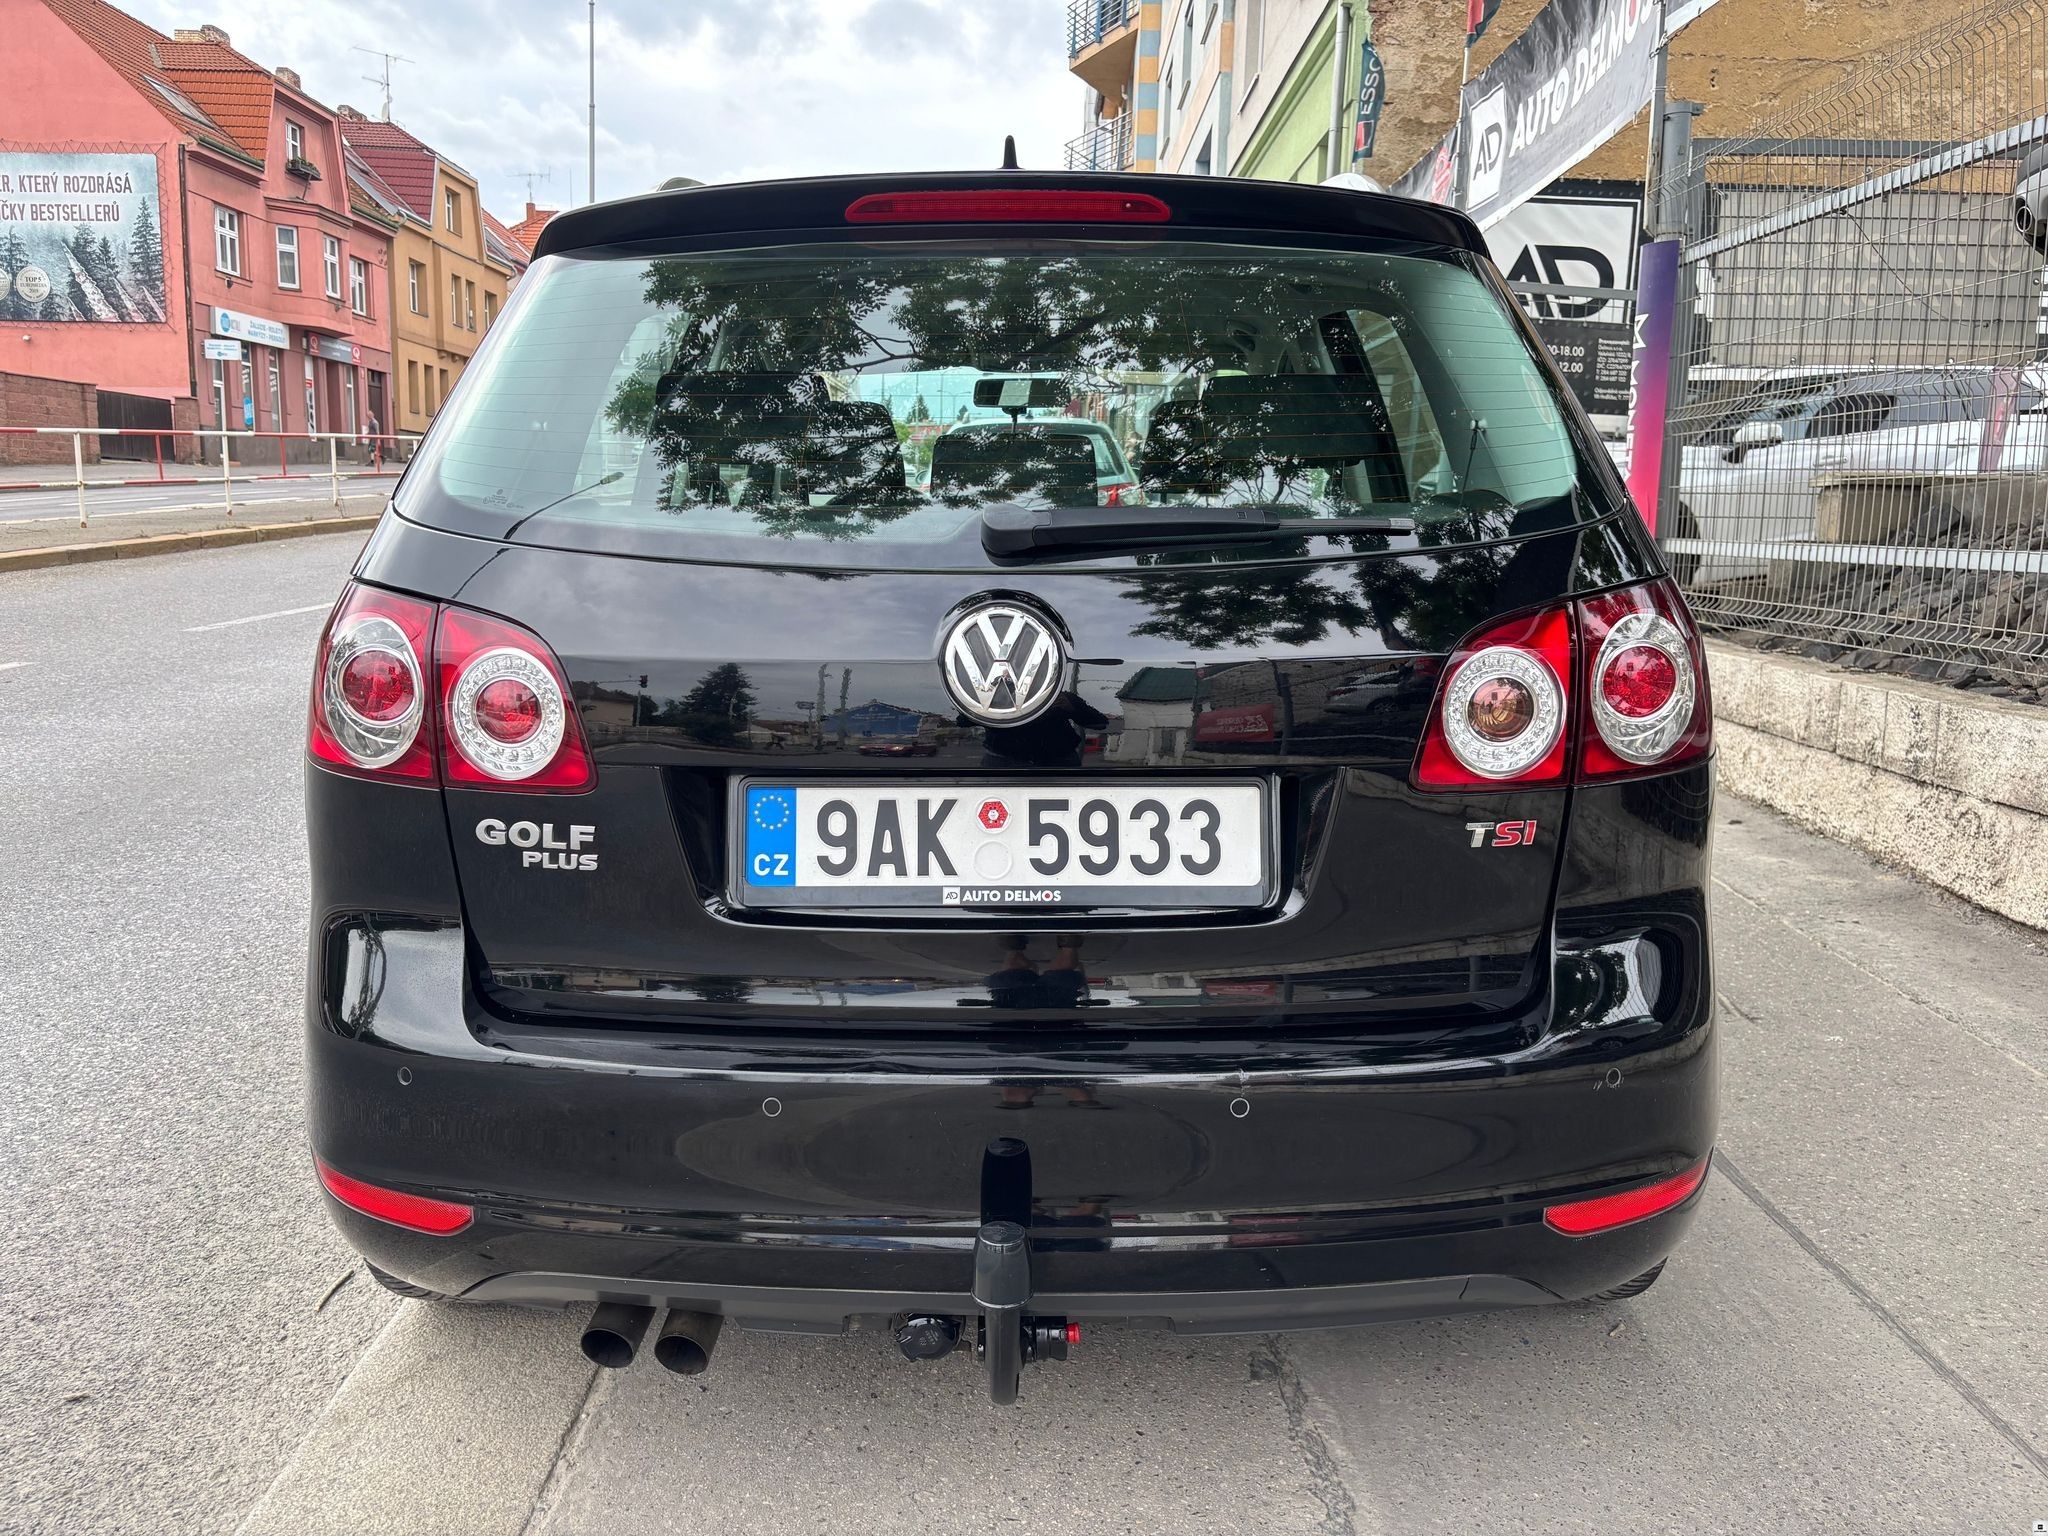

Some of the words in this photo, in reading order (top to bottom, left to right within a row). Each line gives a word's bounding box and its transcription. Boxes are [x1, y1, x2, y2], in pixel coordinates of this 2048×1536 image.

[1508, 67, 1570, 158] AUTO
[19, 171, 58, 193] KTERÝ
[63, 172, 133, 194] ROZDRÁSÁ
[30, 201, 120, 222] BESTSELLERŮ
[475, 818, 596, 850] GOLF
[816, 799, 959, 877] 9AK
[1028, 798, 1222, 876] 5933
[1465, 820, 1537, 848] TSI
[522, 851, 598, 871] PLUS
[753, 853, 789, 876] CZ
[962, 890, 1001, 902] AUTO
[1004, 890, 1062, 902] DELMOS
